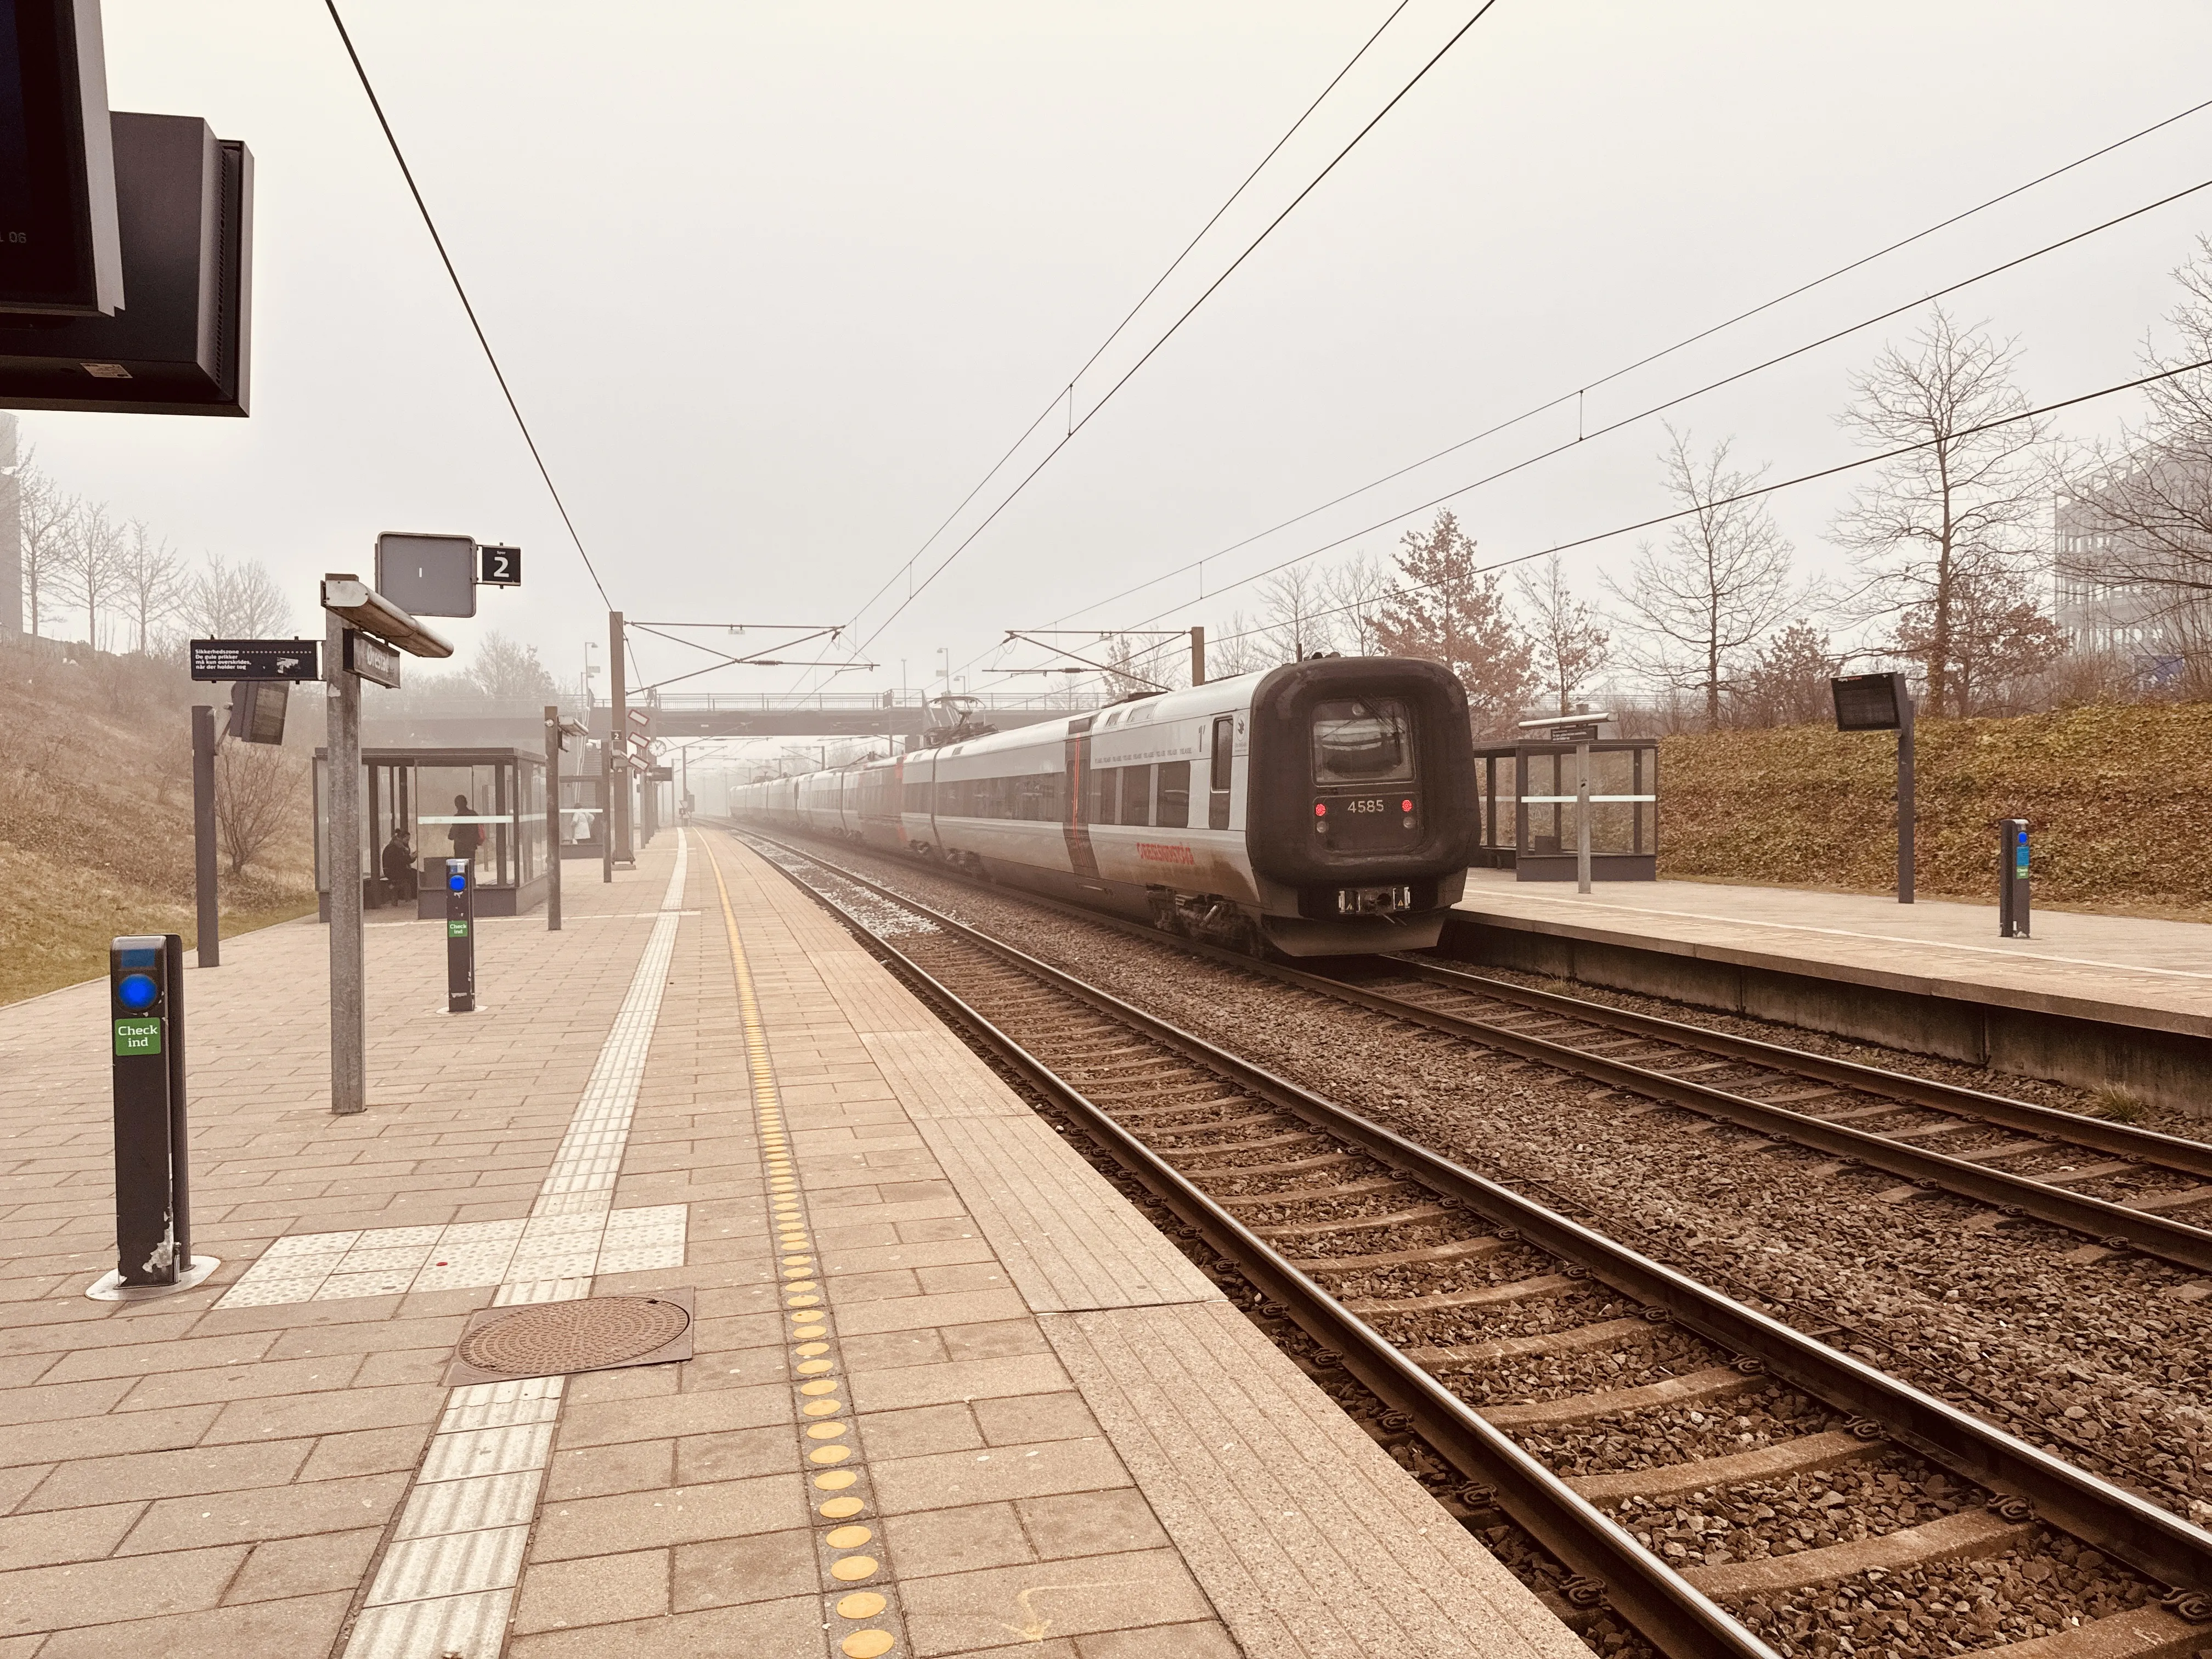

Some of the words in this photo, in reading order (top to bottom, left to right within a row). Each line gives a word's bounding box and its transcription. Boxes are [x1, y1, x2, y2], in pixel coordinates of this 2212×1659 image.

[494, 556, 509, 578] 2
[1347, 799, 1384, 813] 4585
[118, 1025, 158, 1036] Check
[128, 1037, 149, 1047] ind
